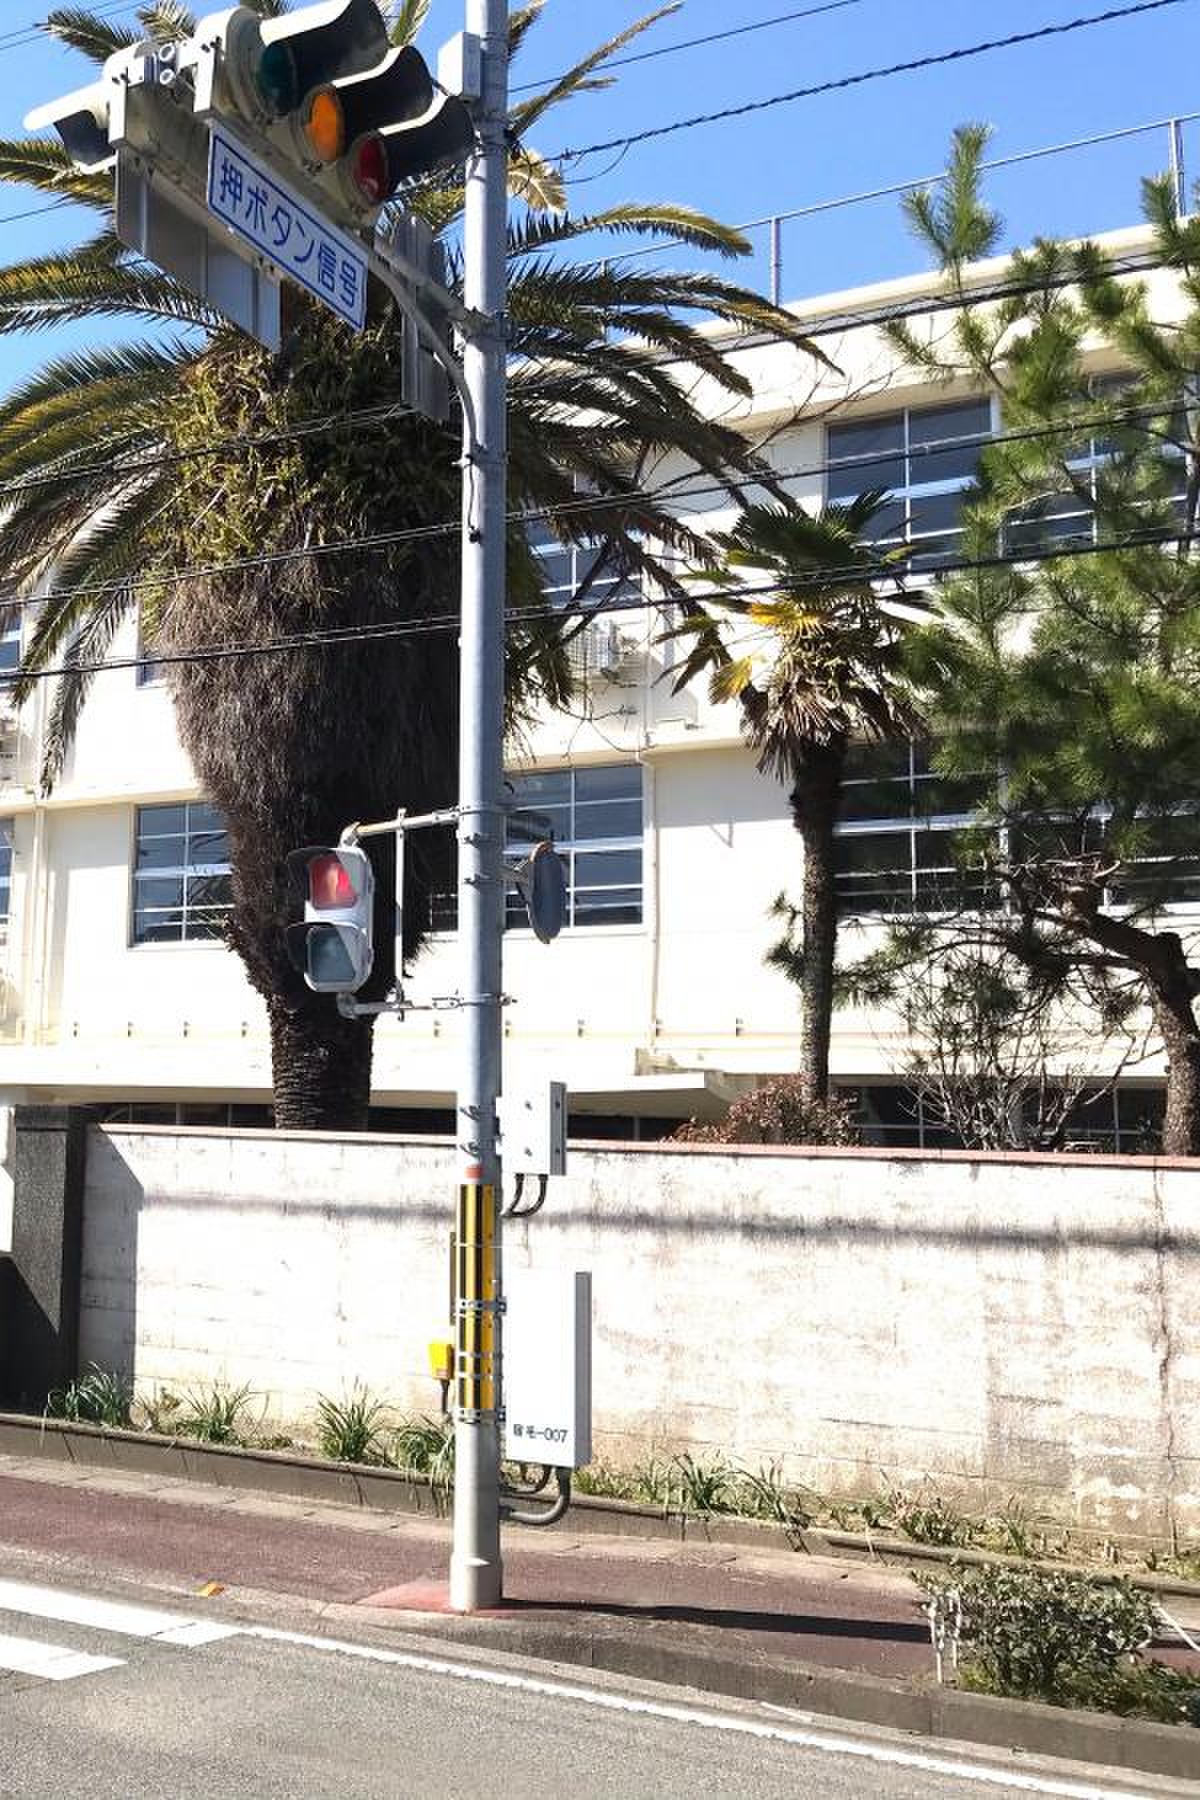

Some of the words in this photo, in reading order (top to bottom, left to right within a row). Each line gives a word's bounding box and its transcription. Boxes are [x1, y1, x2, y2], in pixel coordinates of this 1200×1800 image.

[219, 157, 359, 310] 押ボタン信号
